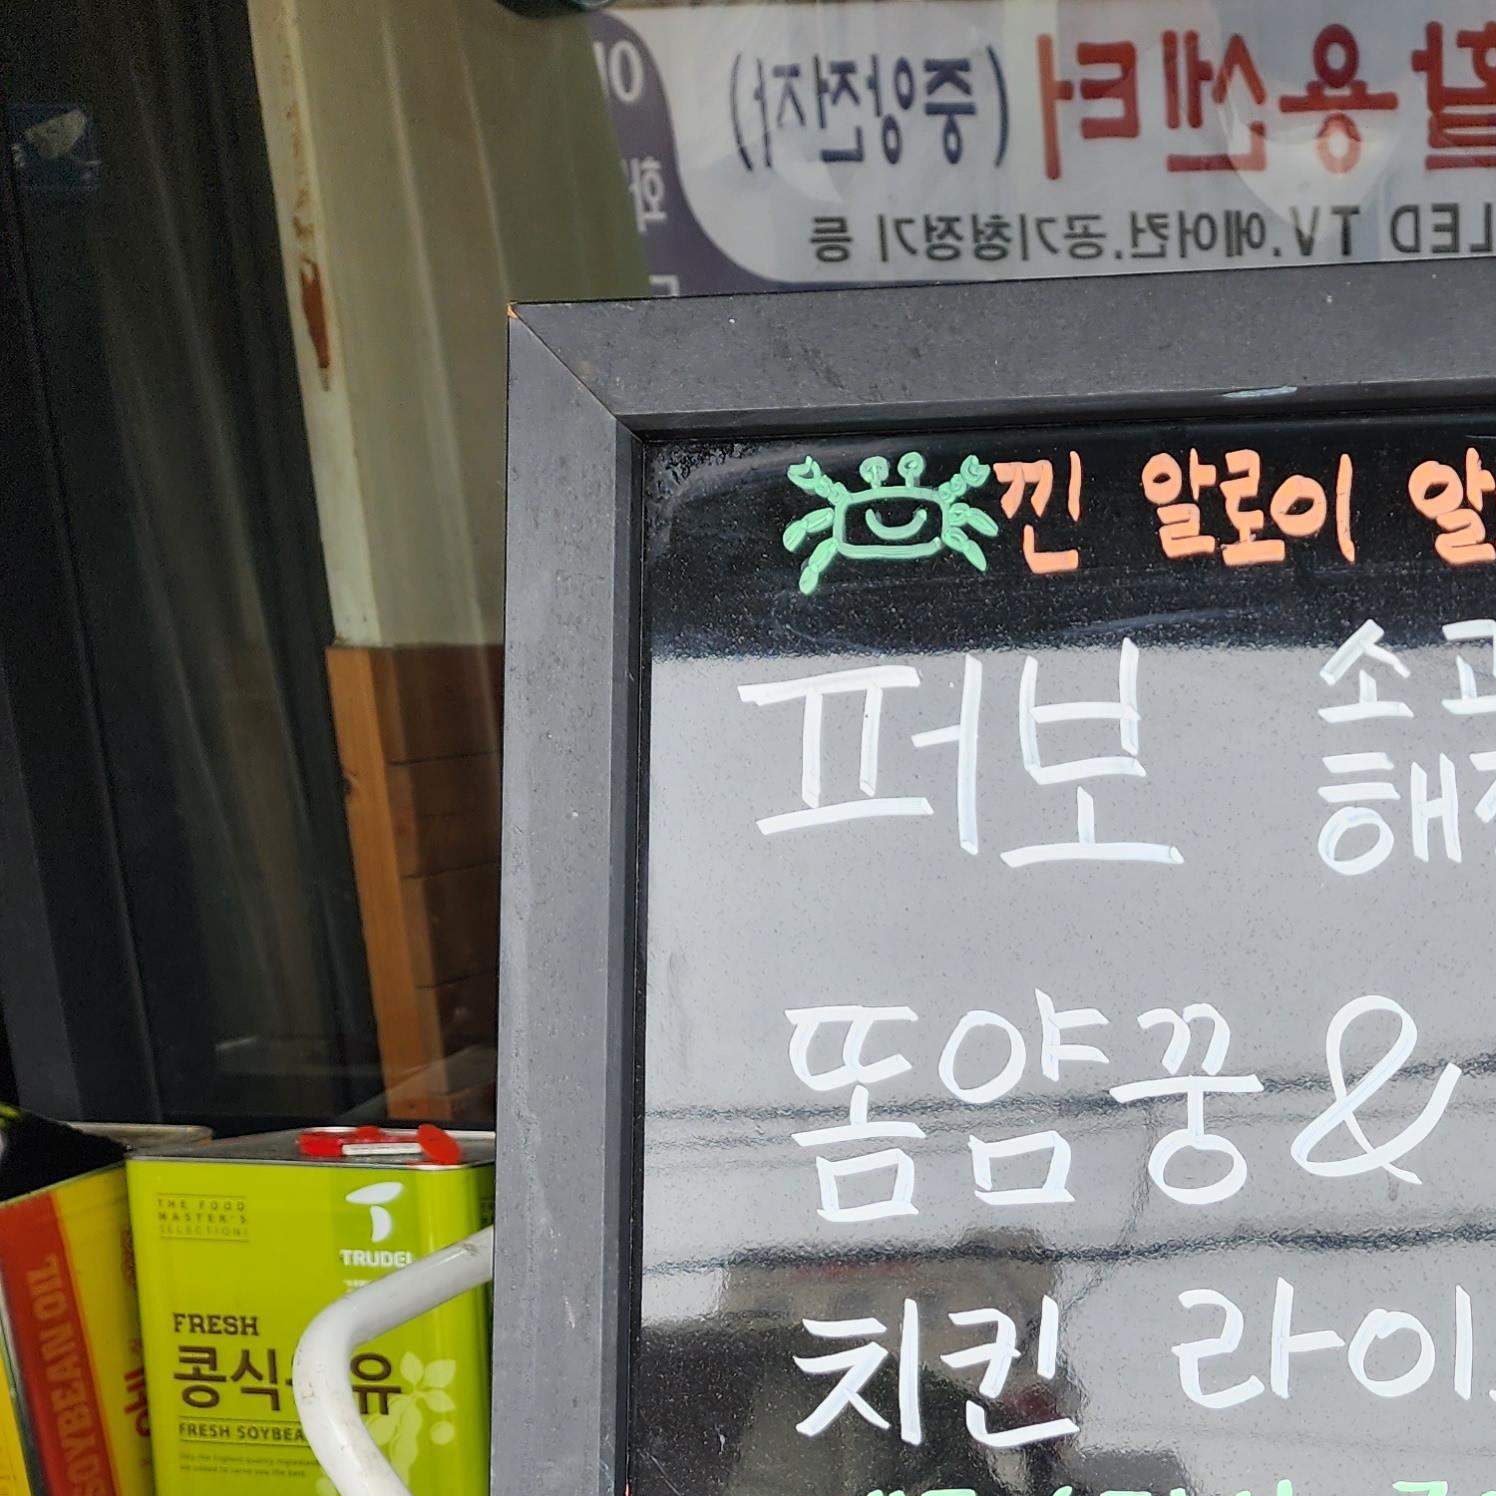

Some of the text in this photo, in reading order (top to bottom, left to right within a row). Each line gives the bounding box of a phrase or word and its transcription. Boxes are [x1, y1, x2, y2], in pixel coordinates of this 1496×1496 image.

[1142, 447, 1356, 567] 알로이
[738, 636, 1185, 871] 퍼보
[786, 986, 1266, 1224] 똠얌꿍
[1290, 994, 1463, 1186] &
[173, 1312, 260, 1336] FRESH
[173, 1345, 402, 1416] 콩식유
[796, 1294, 1081, 1448] 치킨
[179, 1422, 231, 1439] FRESH
